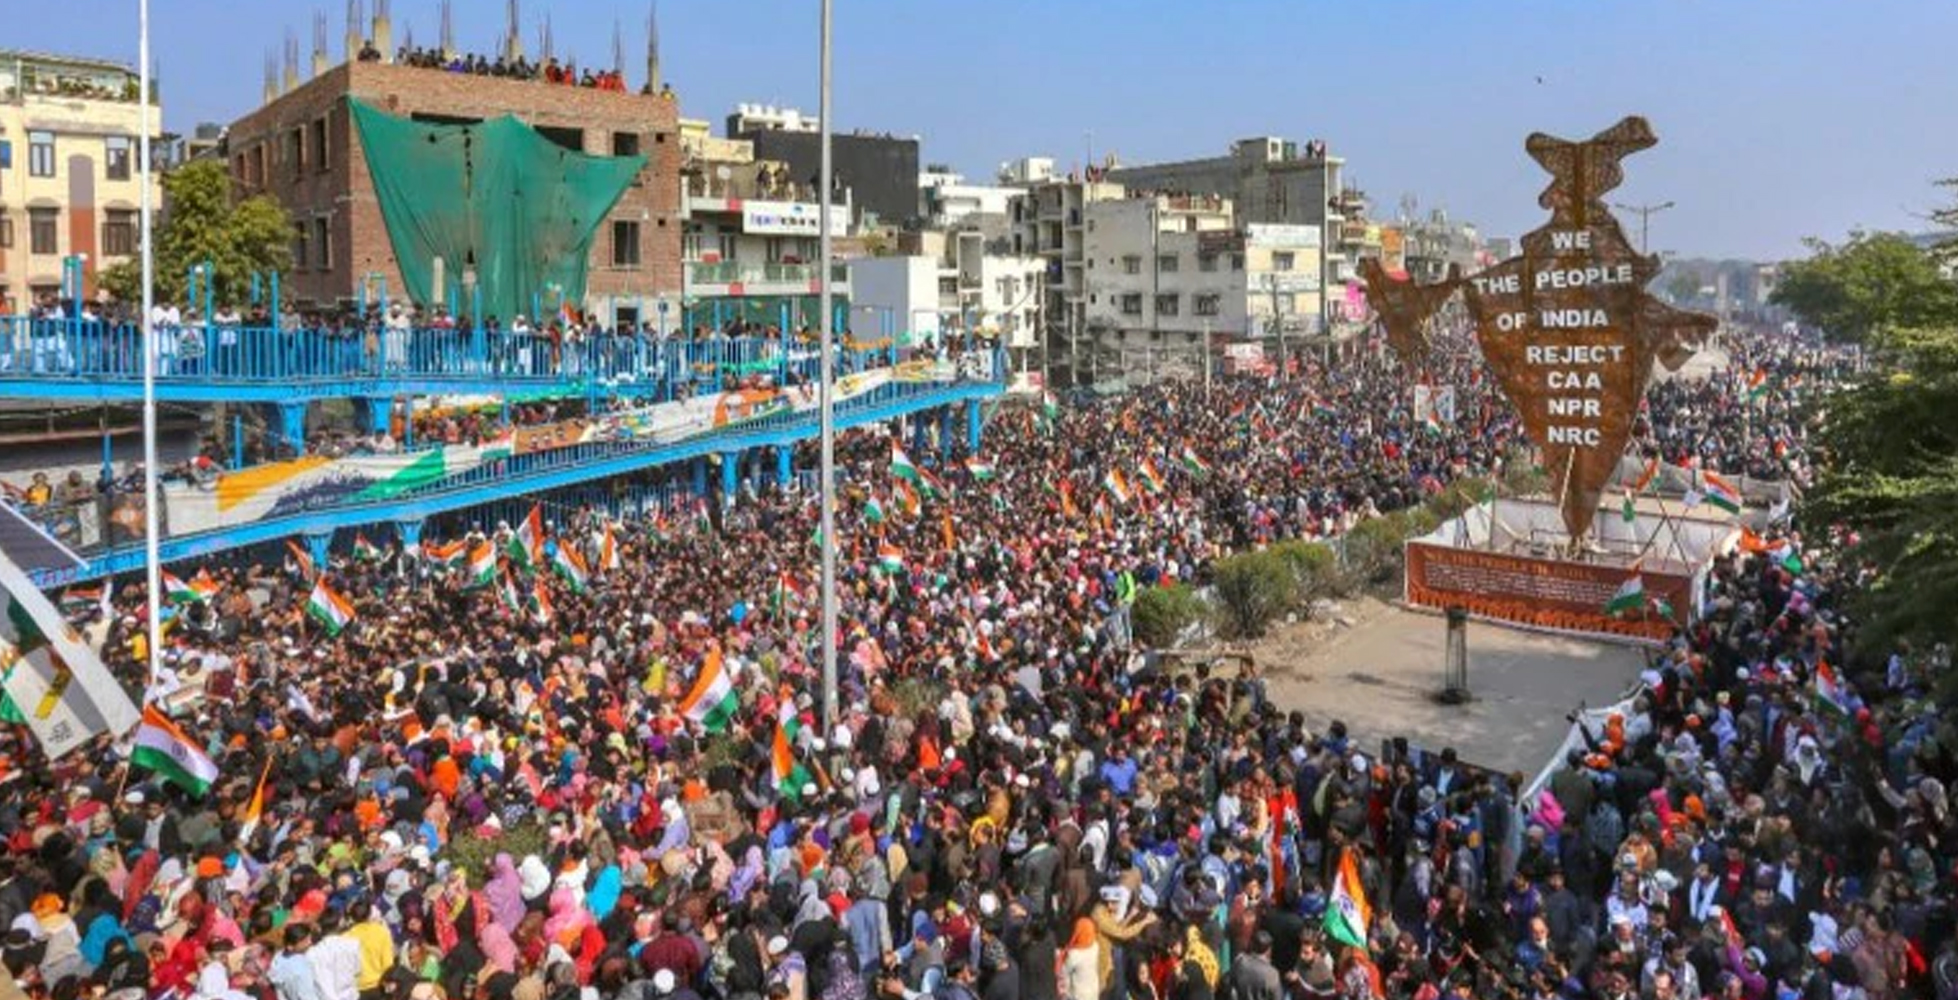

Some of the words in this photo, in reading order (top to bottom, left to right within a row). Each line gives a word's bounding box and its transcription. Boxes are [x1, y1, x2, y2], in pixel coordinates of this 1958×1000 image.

[1552, 231, 1591, 249] WE
[1472, 275, 1521, 295] THE
[1535, 264, 1632, 290] PEOPLE
[1496, 312, 1527, 332] OF
[1542, 308, 1609, 328] INDIA
[1526, 345, 1625, 364] REJECT
[1547, 371, 1602, 389] CAA
[1547, 398, 1601, 417] NPR
[1547, 425, 1601, 447] NRC
